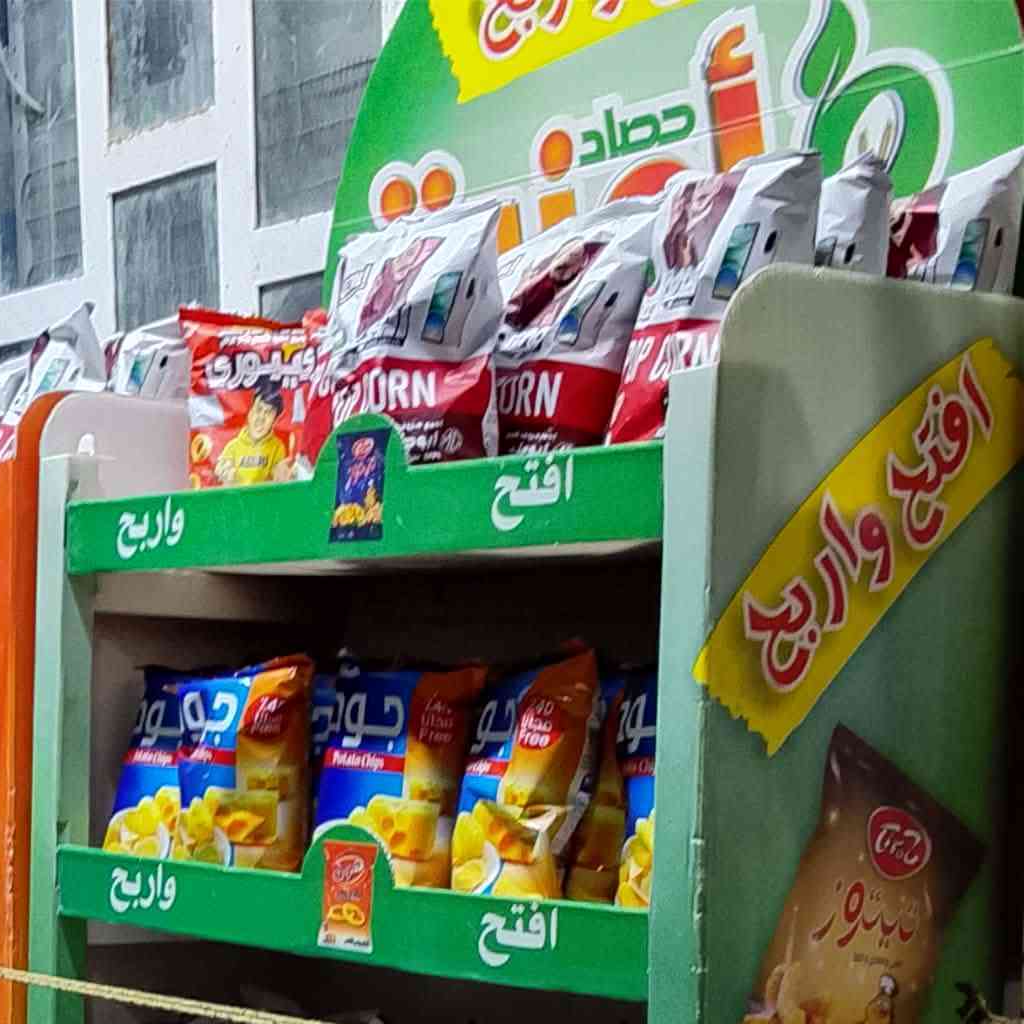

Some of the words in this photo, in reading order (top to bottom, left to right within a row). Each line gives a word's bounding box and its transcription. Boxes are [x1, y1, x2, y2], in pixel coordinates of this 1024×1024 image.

[579, 101, 697, 166] حصاد
[886, 352, 992, 549] افتح
[490, 455, 574, 531] افتح
[116, 496, 184, 558] واربح
[743, 488, 894, 692] واربح
[110, 863, 176, 912] واربح
[478, 904, 558, 967] افتح
